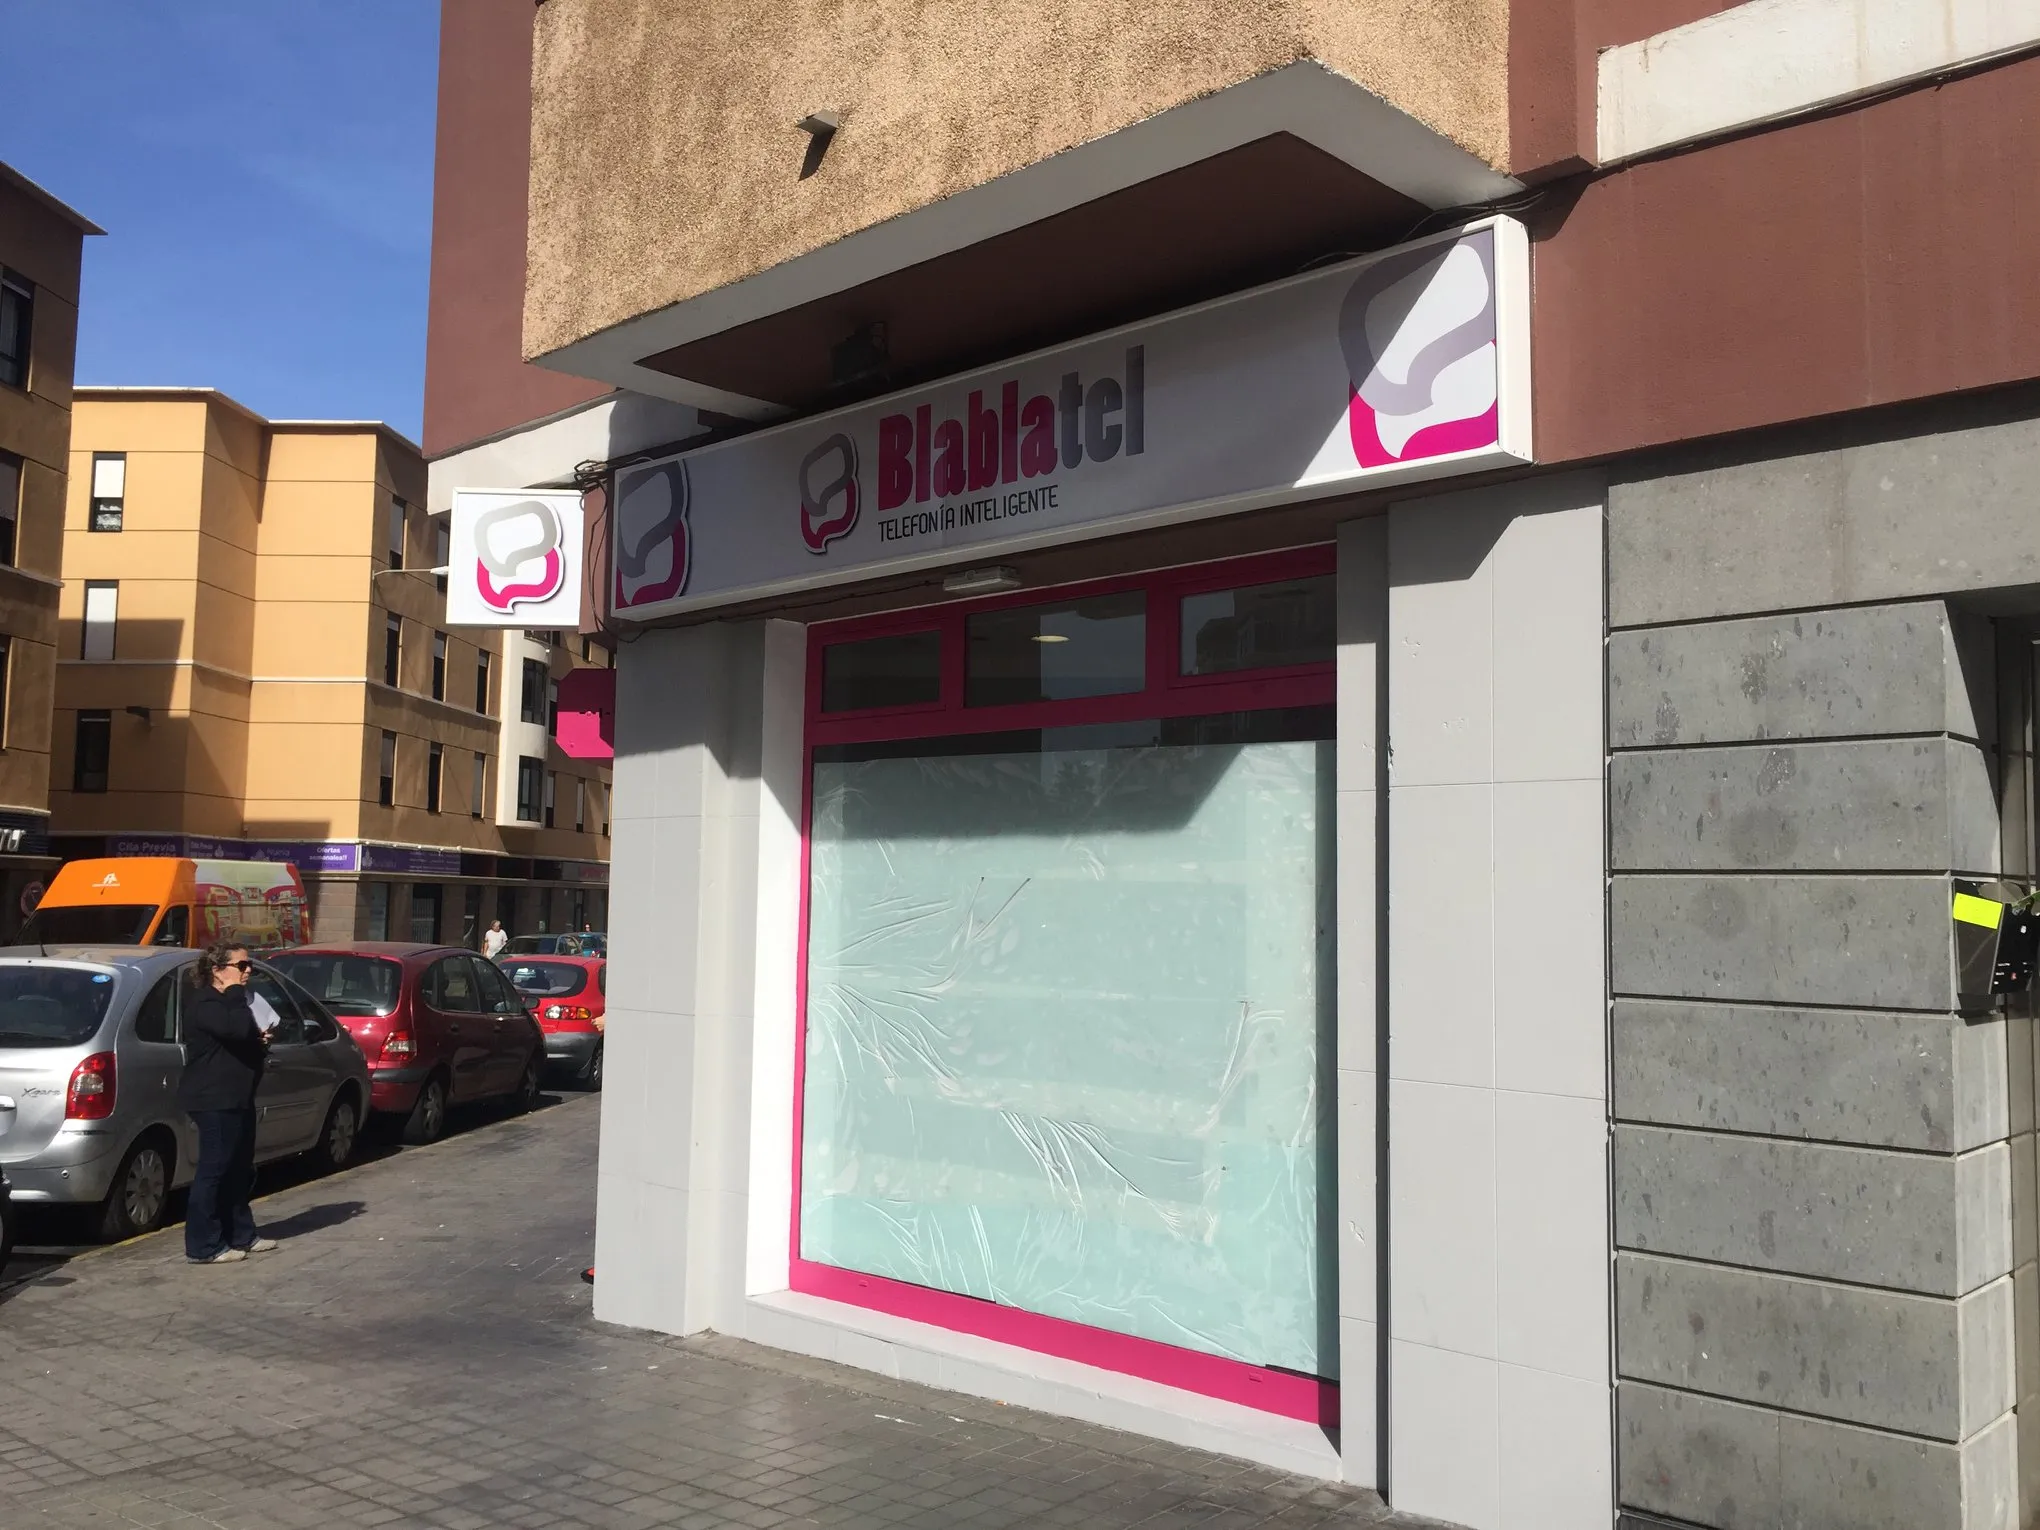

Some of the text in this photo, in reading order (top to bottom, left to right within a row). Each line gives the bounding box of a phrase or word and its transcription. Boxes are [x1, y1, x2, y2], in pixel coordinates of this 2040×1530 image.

[878, 345, 1144, 511] Blablatel
[878, 485, 1059, 542] TELEFONÍA INTELIGENTE
